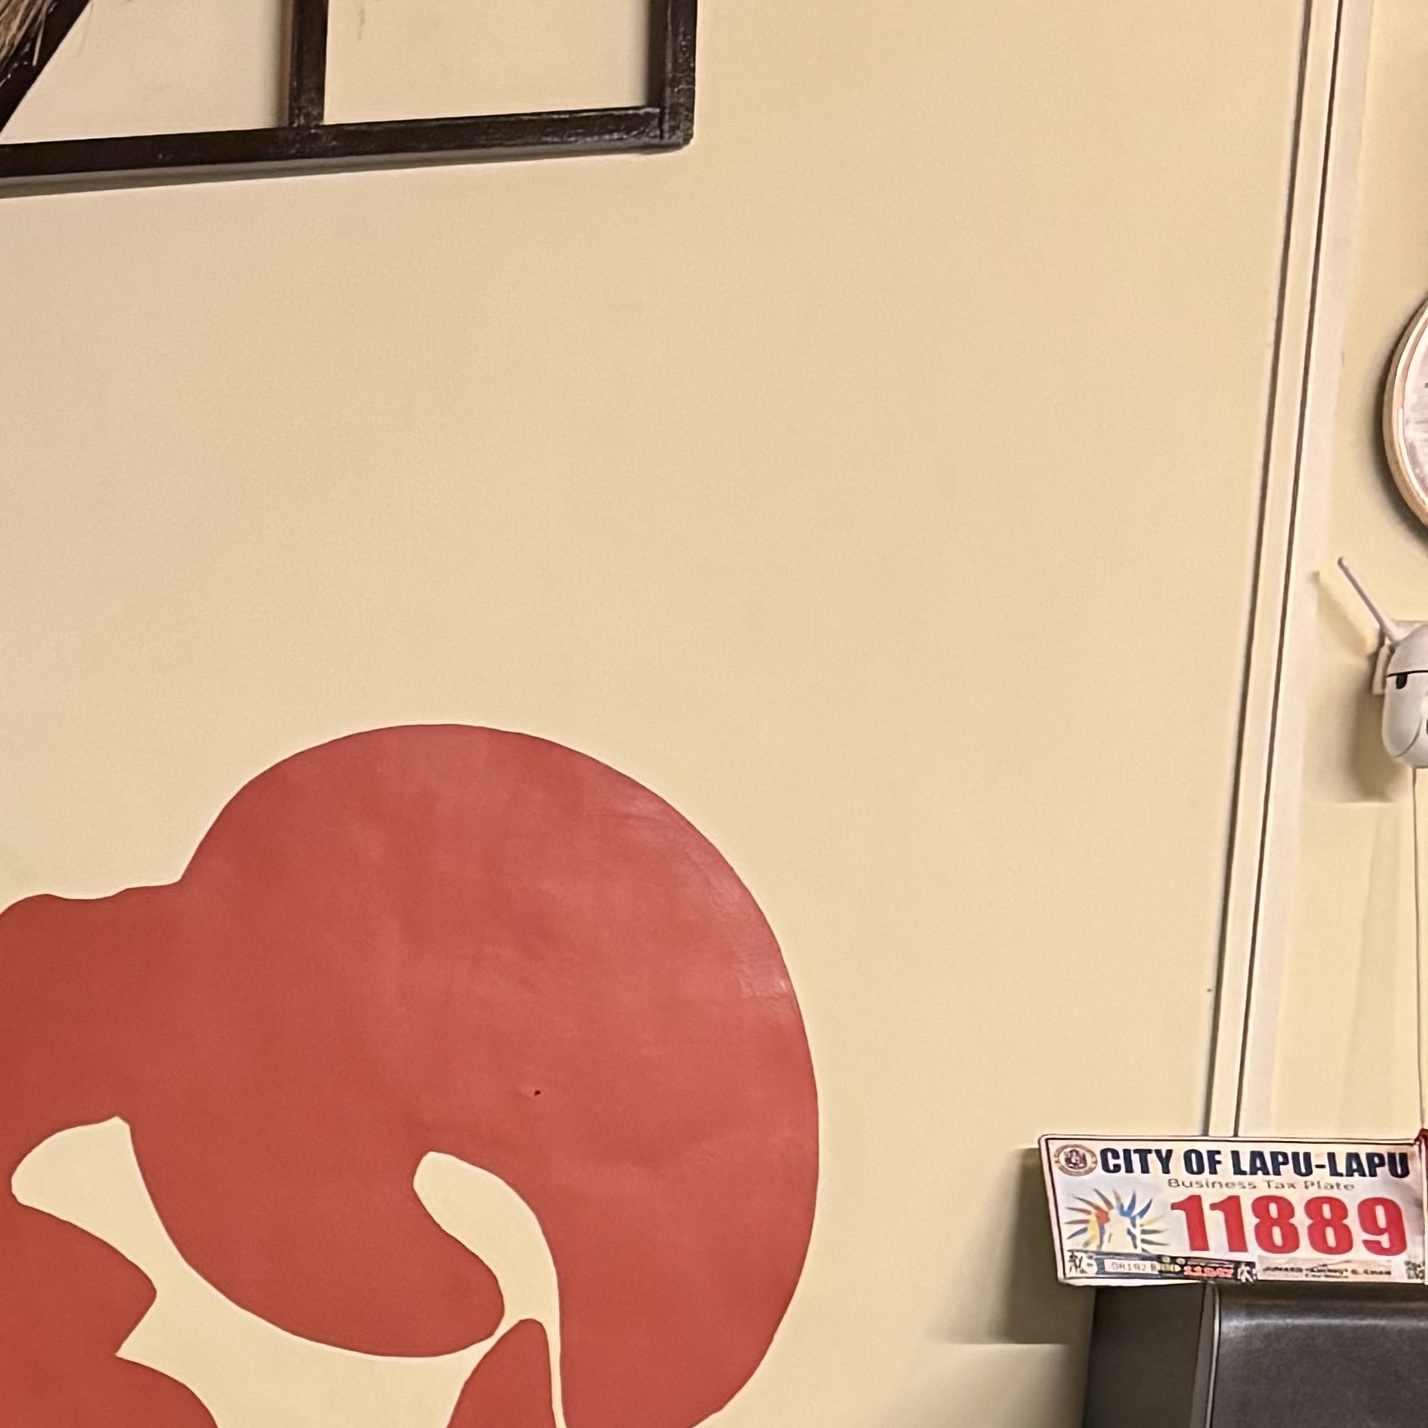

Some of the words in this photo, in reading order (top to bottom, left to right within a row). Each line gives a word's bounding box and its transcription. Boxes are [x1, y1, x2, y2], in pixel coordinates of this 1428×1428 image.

[1099, 1147, 1173, 1174] CITY
[1183, 1149, 1222, 1175] OF
[1231, 1150, 1411, 1179] LAPU-LAPU
[1167, 1178, 1257, 1190] Business
[1265, 1179, 1297, 1190] Tax
[1304, 1180, 1356, 1191] Plate
[1171, 1194, 1409, 1257] 11889
